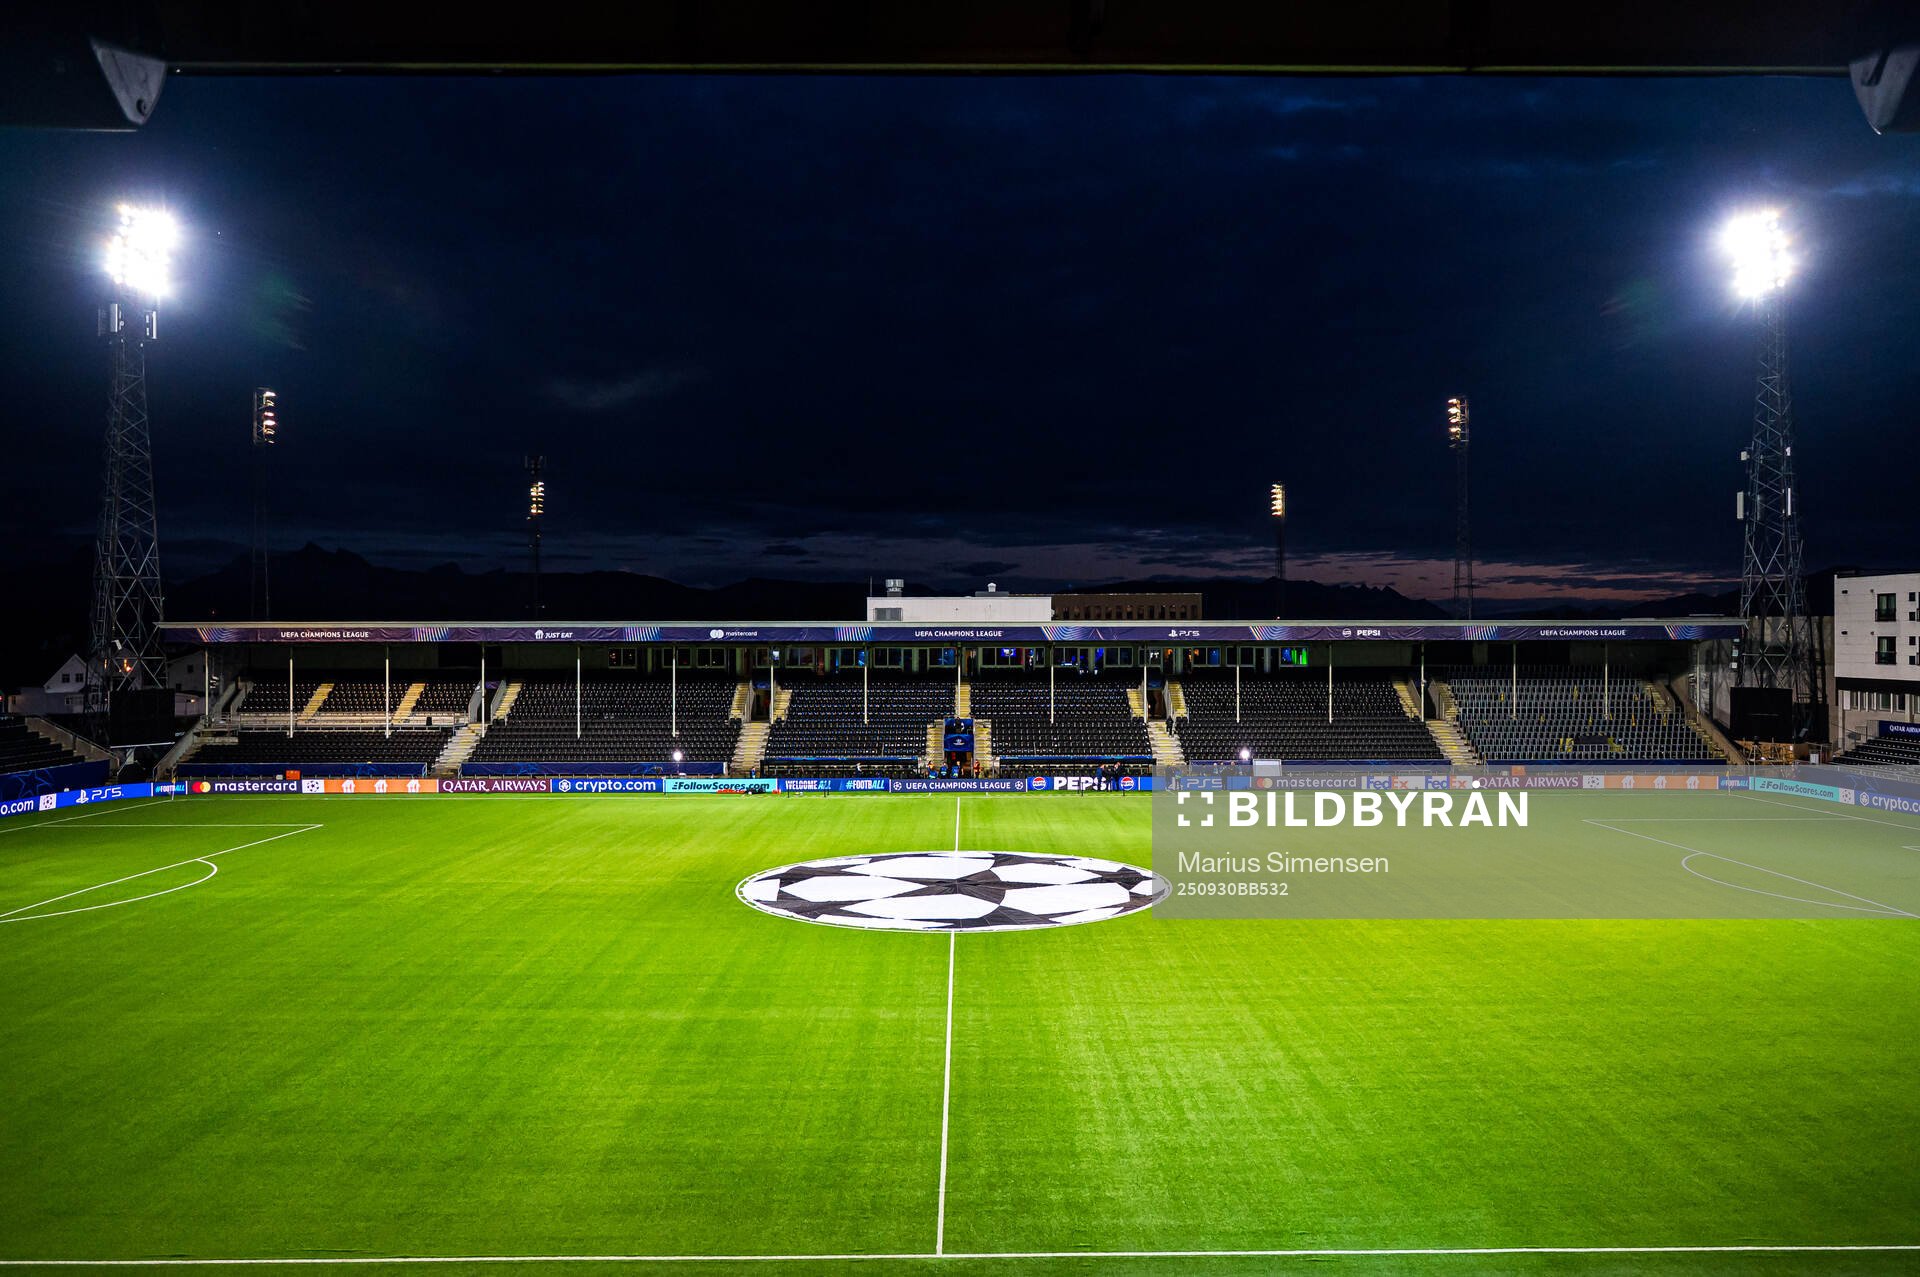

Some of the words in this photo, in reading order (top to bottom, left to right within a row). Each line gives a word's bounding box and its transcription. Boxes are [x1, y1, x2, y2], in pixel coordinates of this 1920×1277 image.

[214, 781, 297, 792] mastercard
[442, 781, 487, 792] QATAR
[492, 781, 547, 791] AIRWAYS
[575, 779, 656, 793] crypto.com
[678, 781, 770, 790] FollowScores.com
[785, 780, 818, 790] WELCOME
[845, 780, 885, 790] #FOOTBALL
[905, 782, 928, 790] UEFA
[929, 782, 978, 790] CHAMPIONS
[980, 781, 1011, 789] LEAGUE
[1053, 776, 1112, 791] PEPS
[1276, 777, 1357, 788] mastercard
[1366, 775, 1409, 790] FedEx
[1425, 775, 1468, 790] FedEx
[1479, 776, 1520, 789] QATAR
[1525, 776, 1579, 787] AIRWAYS
[91, 787, 122, 800] PS5
[1766, 781, 1834, 798] FollowScores.com
[1872, 796, 1920, 812] crypto.c
